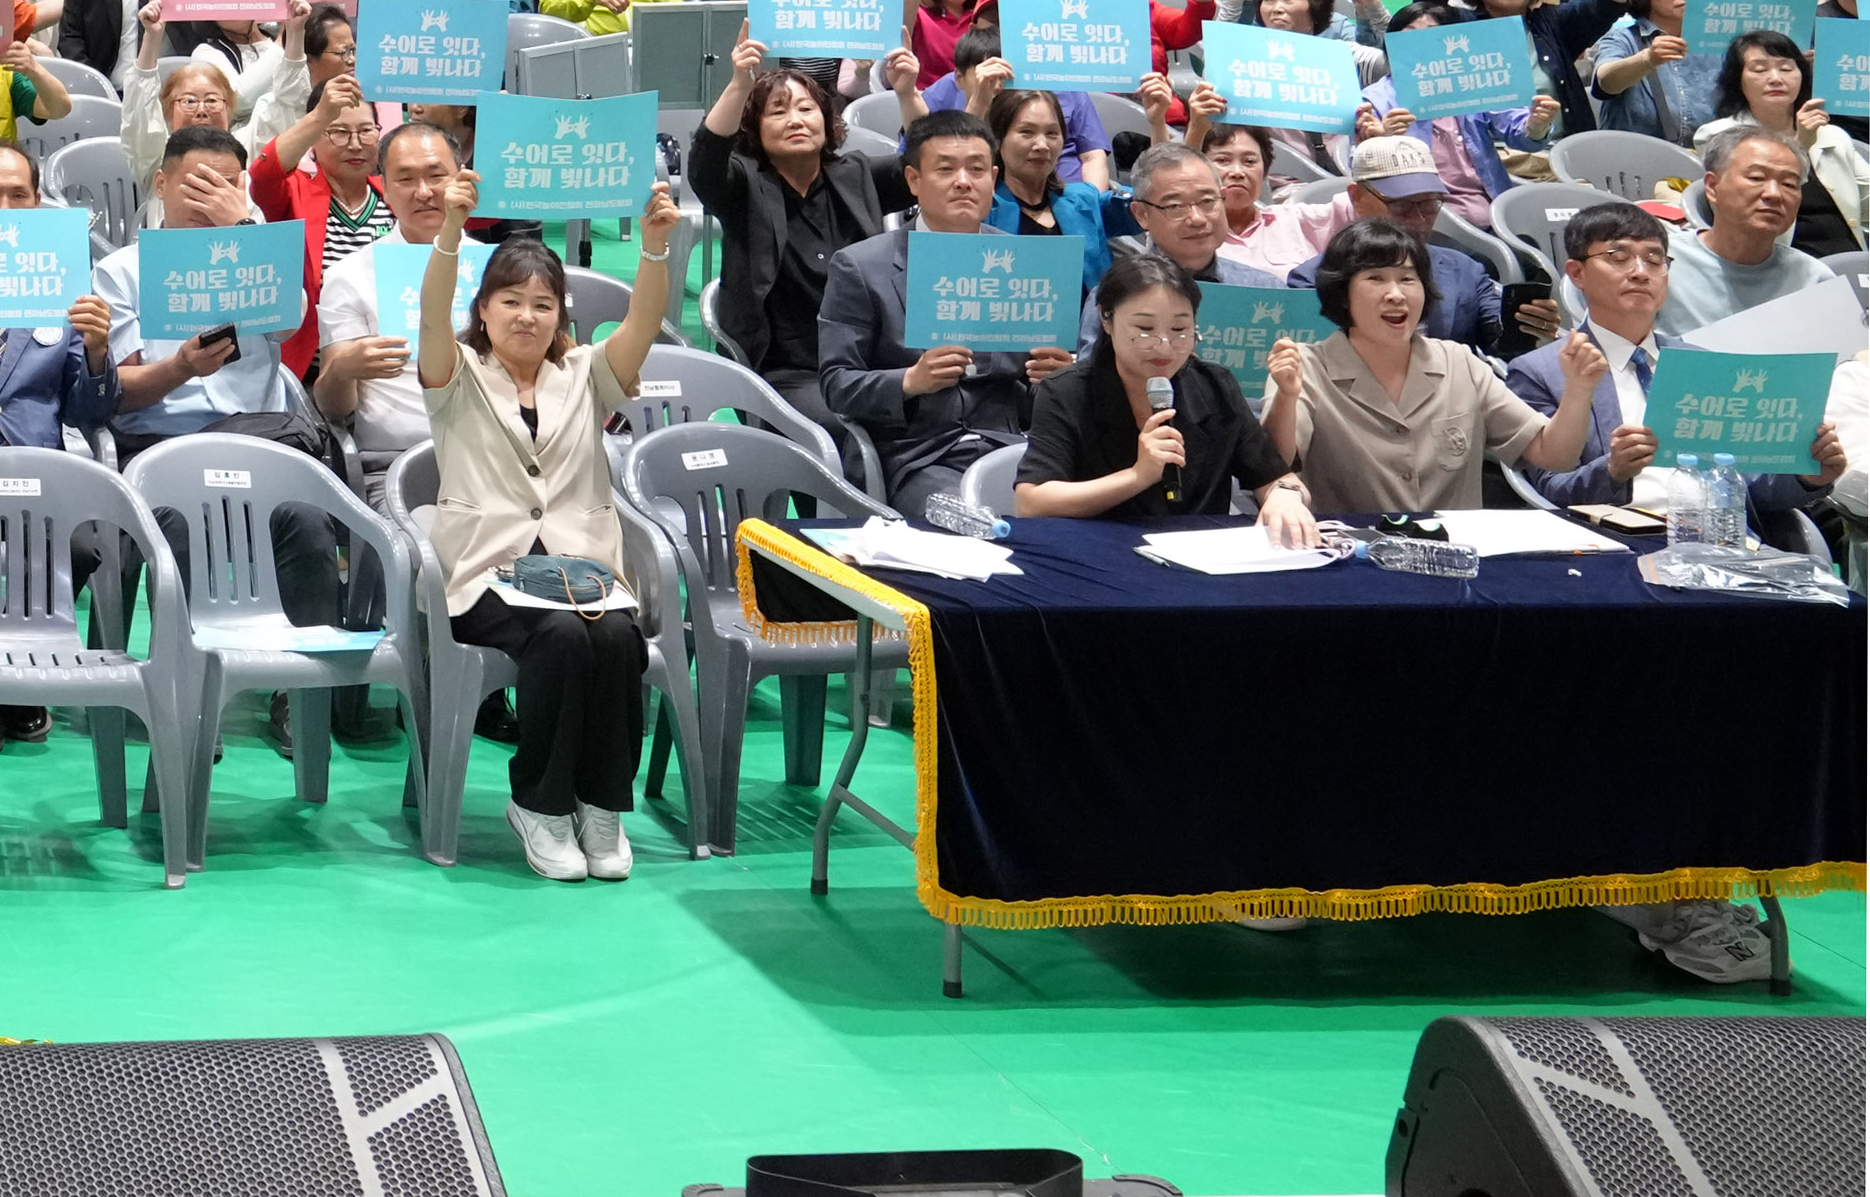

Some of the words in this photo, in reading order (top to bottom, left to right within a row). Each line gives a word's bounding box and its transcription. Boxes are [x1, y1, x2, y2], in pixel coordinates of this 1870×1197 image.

[501, 142, 574, 166] 수어로
[581, 140, 635, 166] 잇다,
[504, 167, 553, 189] 함께
[562, 164, 630, 189] 빛나다
[14, 252, 66, 276] 잇다,
[933, 276, 998, 300] 수어로
[1007, 277, 1059, 301] 잇다,
[935, 299, 983, 323] 함께
[989, 300, 1054, 323] 빛나다
[1676, 393, 1748, 417] 수어로
[1756, 396, 1804, 419] 잇다,
[1674, 416, 1720, 442] 함께
[1730, 417, 1798, 444] 빛나다
